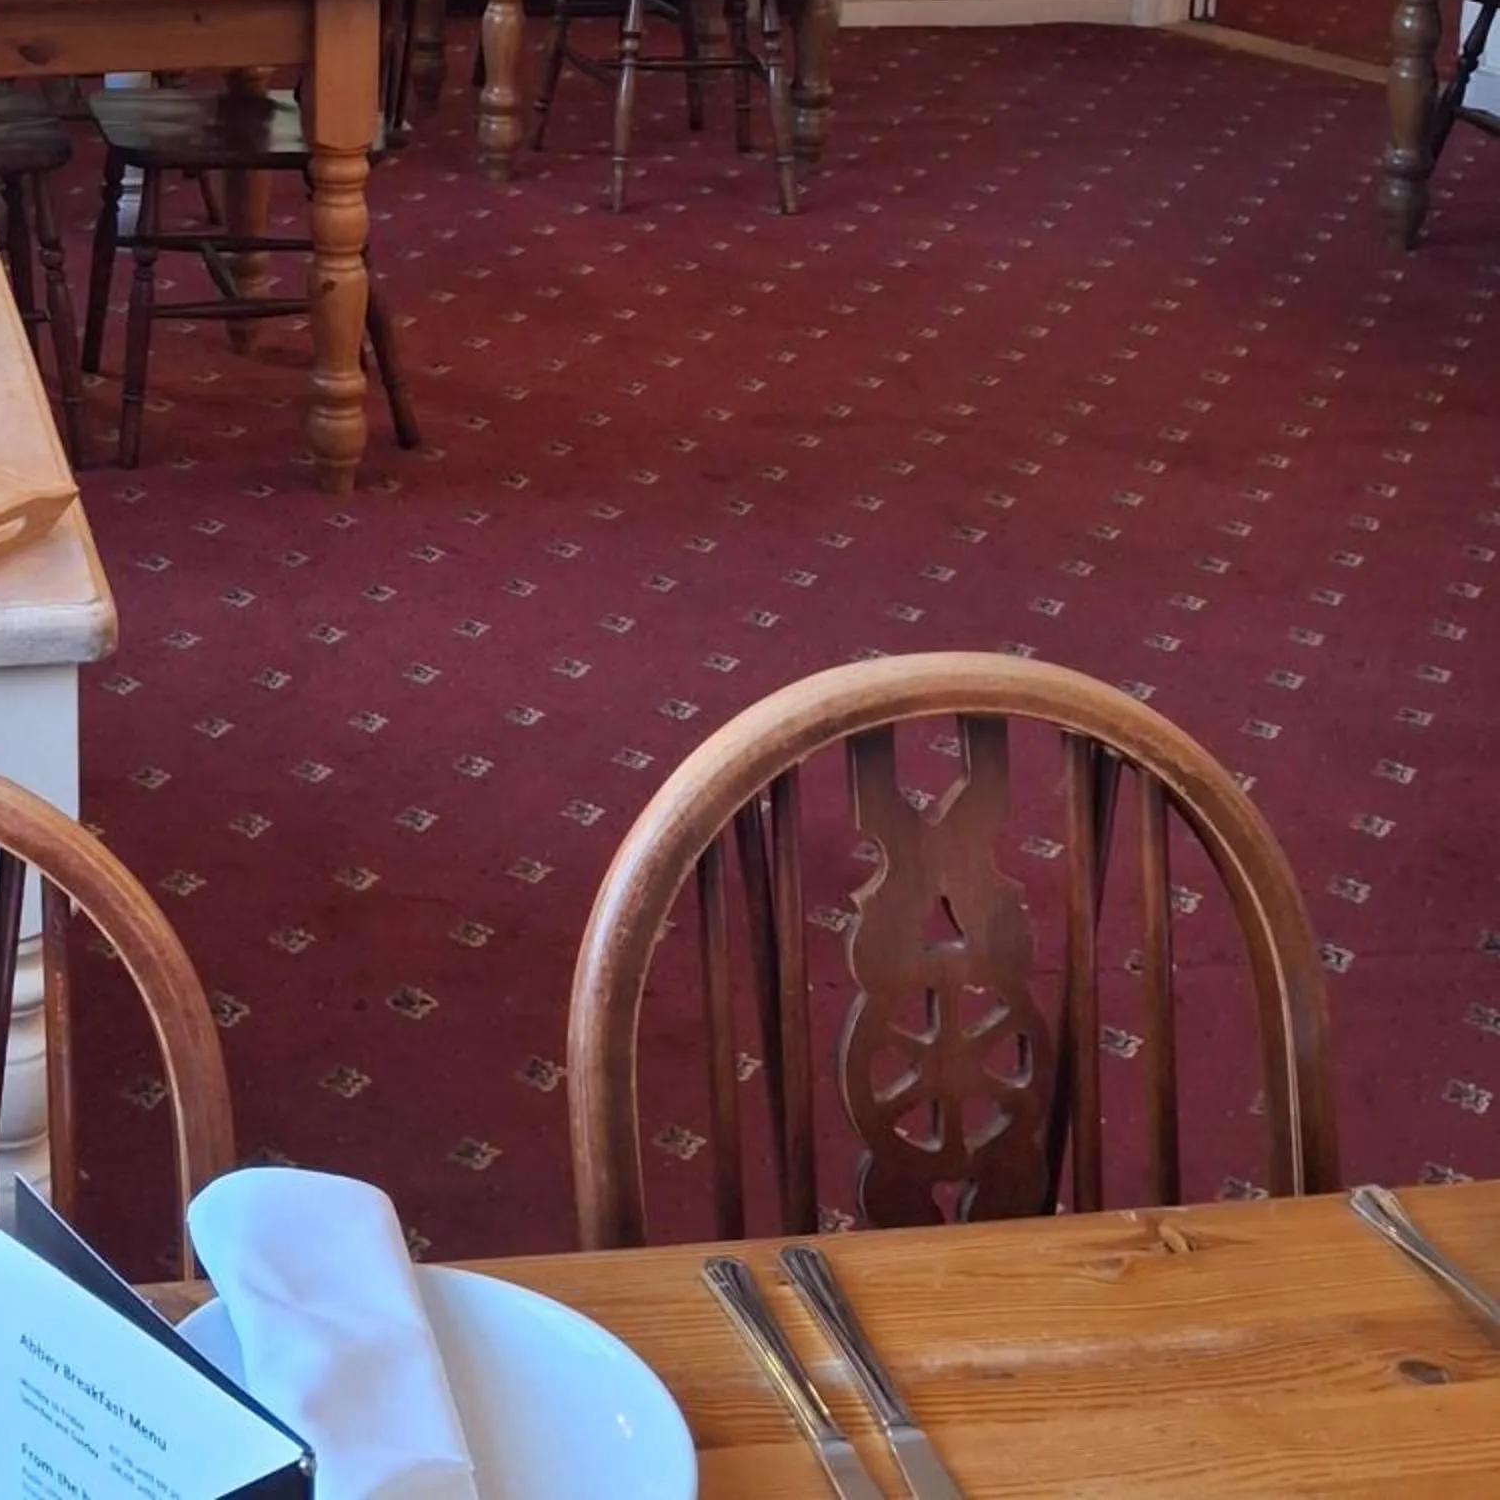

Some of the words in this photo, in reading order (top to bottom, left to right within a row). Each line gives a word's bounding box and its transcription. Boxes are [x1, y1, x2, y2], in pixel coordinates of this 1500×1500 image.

[19, 1333, 59, 1375] Abbey
[63, 1362, 125, 1421] Breakfast
[128, 1411, 167, 1452] Menu
[21, 1442, 54, 1477] From
[56, 1471, 78, 1496] the
